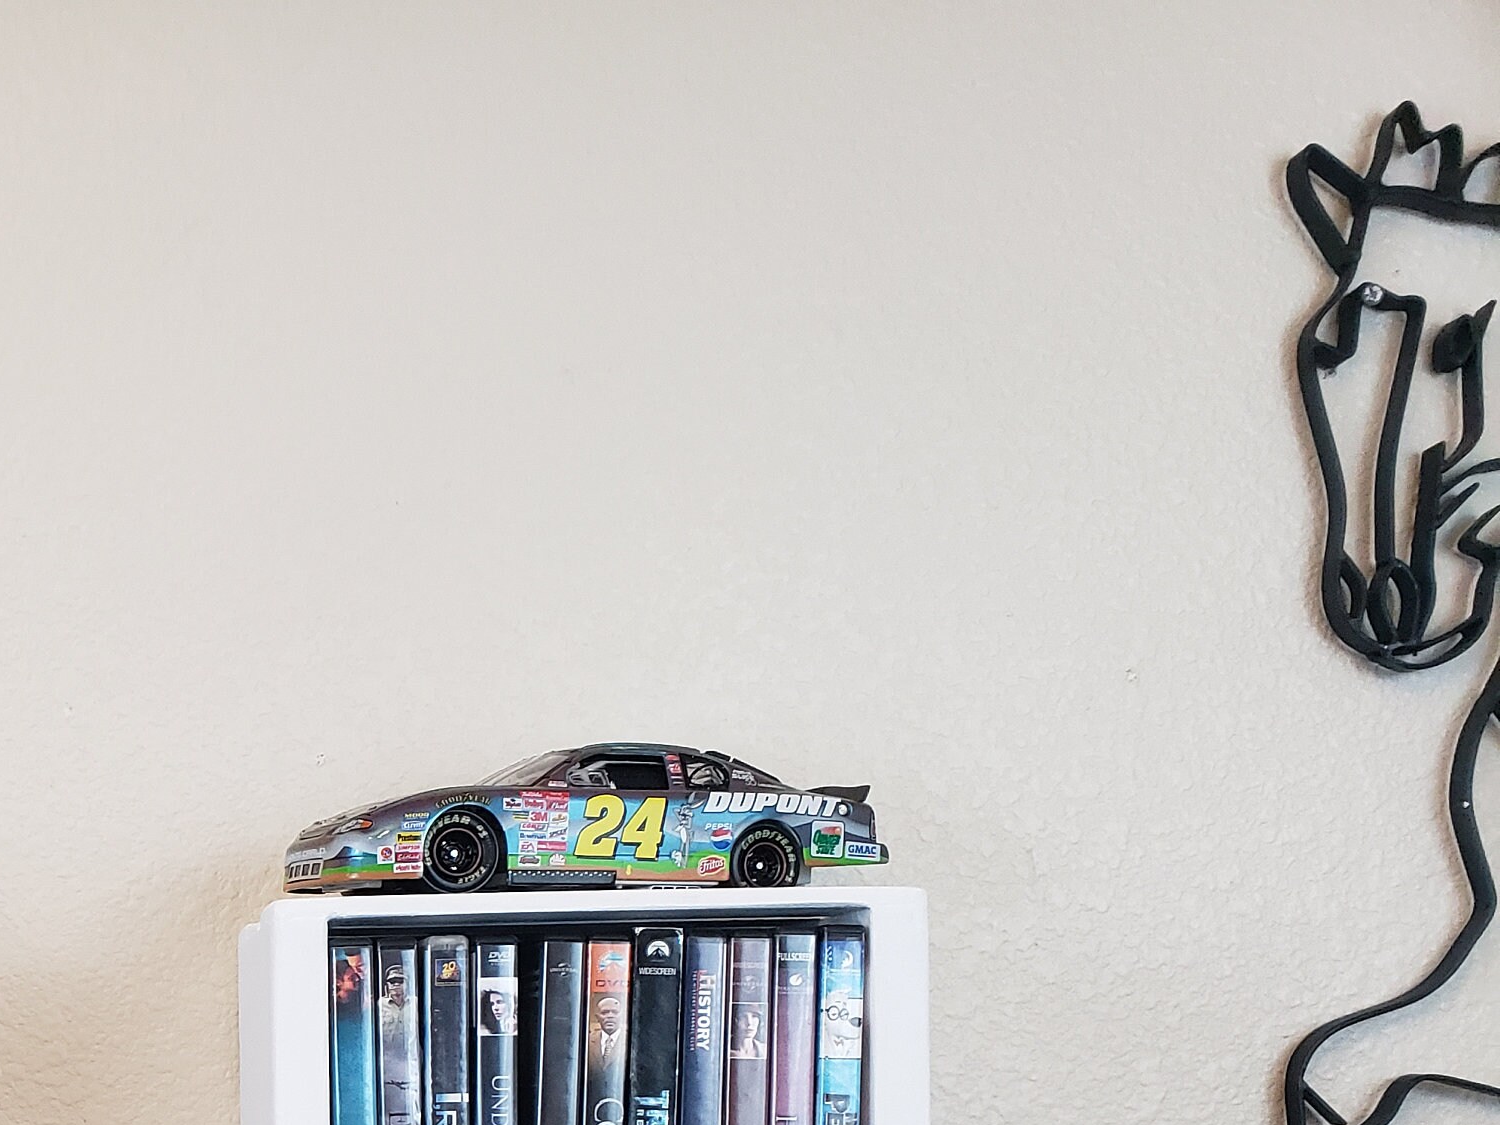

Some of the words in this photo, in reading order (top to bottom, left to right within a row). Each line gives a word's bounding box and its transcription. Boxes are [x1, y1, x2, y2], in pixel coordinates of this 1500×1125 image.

[703, 791, 842, 817] DUPONT
[530, 811, 548, 822] 3M
[574, 794, 667, 859] 24
[705, 822, 733, 831] PEPSI
[741, 829, 797, 863] GOODYEAR
[848, 844, 877, 855] GMAC
[700, 858, 726, 873] Fritos
[488, 951, 511, 959] DVD
[638, 967, 677, 976] WIDESCREEN
[696, 972, 717, 1051] HISTORY
